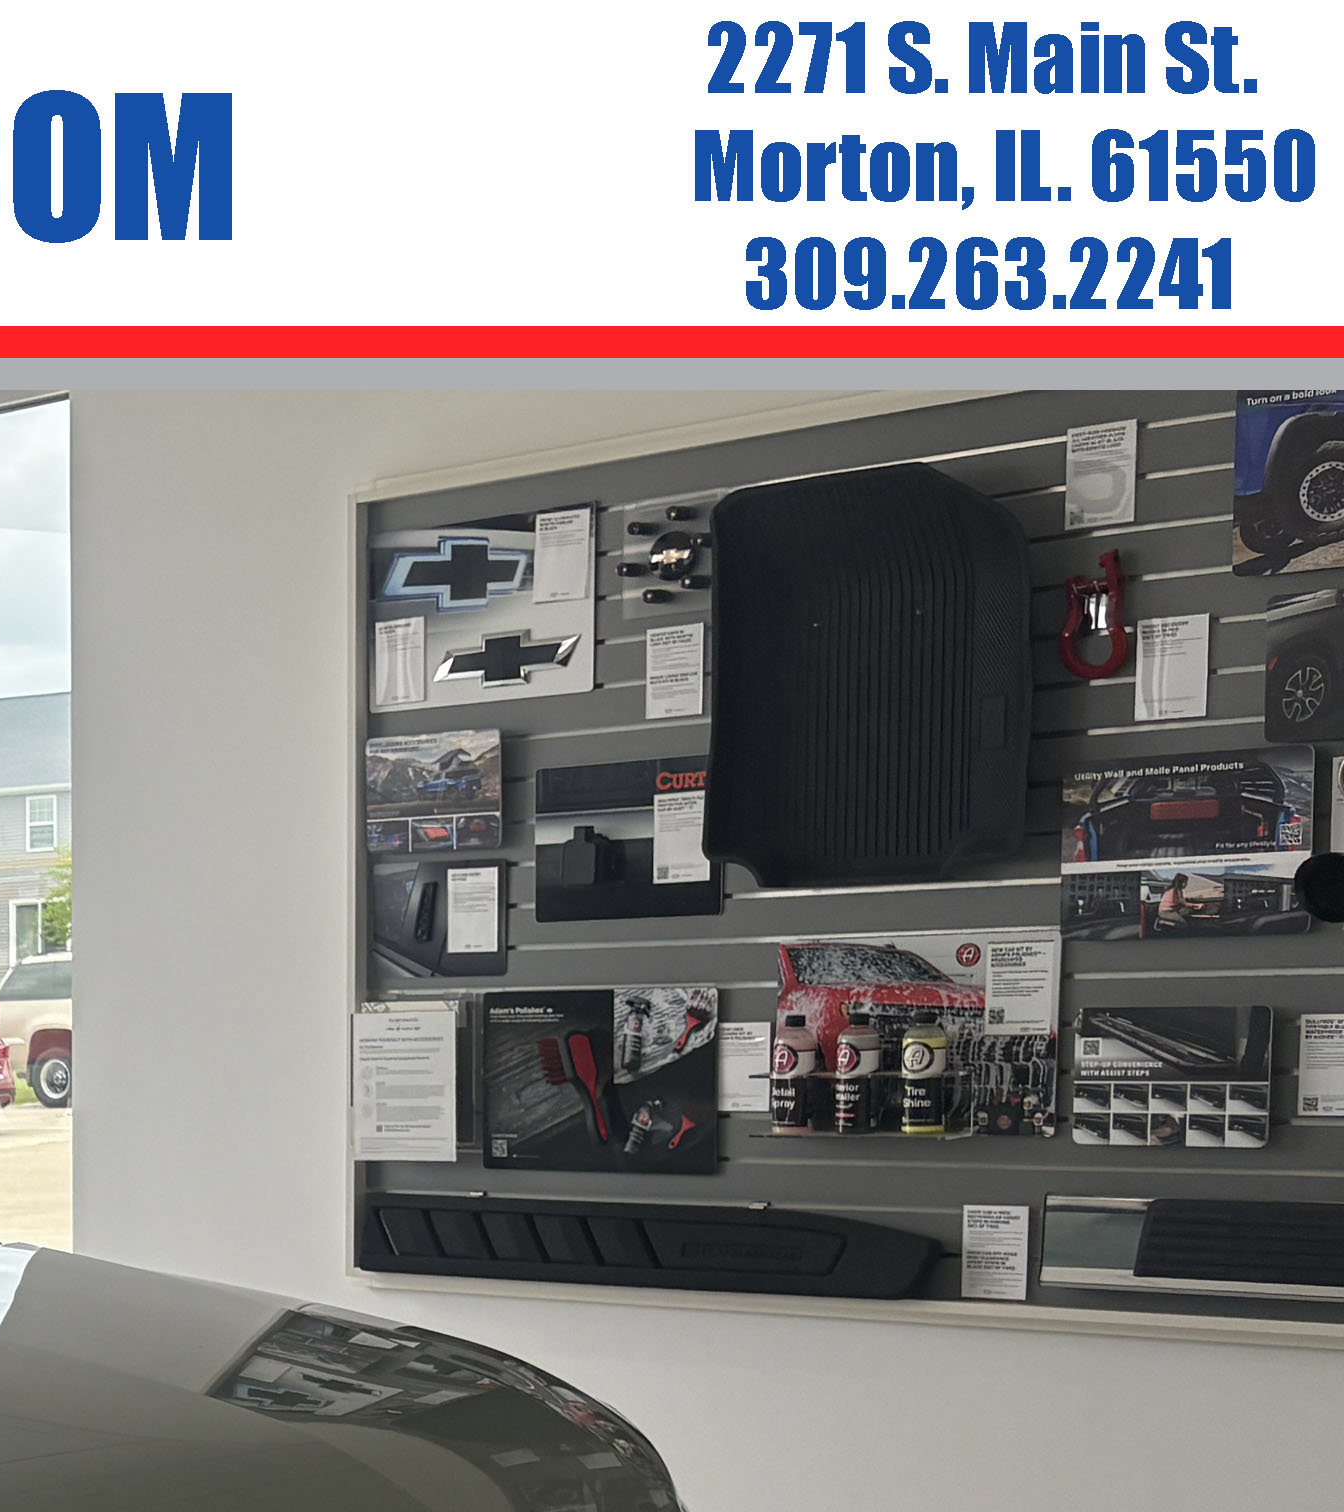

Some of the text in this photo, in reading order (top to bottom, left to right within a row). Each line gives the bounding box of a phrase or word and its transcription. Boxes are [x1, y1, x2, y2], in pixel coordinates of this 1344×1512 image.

[1247, 397, 1268, 406] Turn
[1269, 394, 1282, 403] on
[1283, 393, 1291, 401] a
[1292, 390, 1314, 400] bold
[1074, 772, 1102, 782] Utility
[1104, 769, 1124, 779] Wall
[1126, 768, 1143, 777] and
[1172, 764, 1199, 774] Panel
[1200, 761, 1244, 772] Products
[656, 770, 707, 791] CURT
[904, 1085, 926, 1097] Tire
[903, 1097, 932, 1108] Shine
